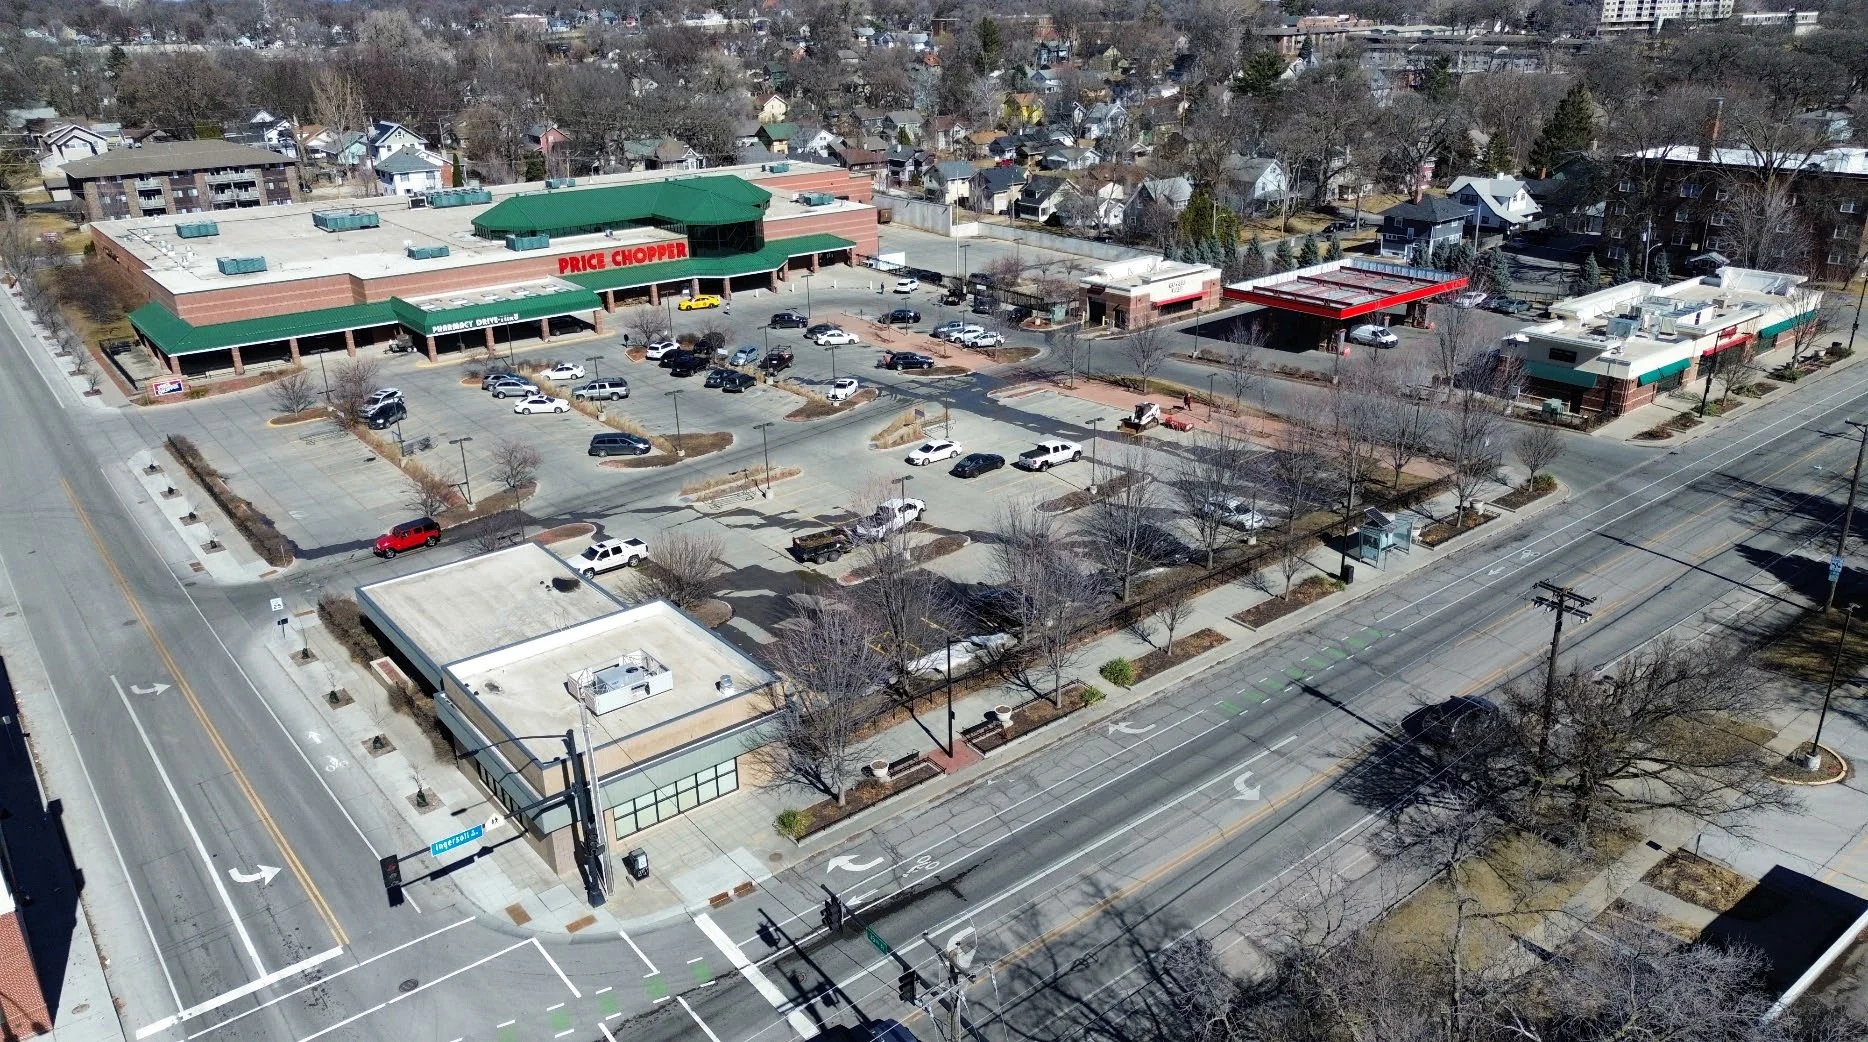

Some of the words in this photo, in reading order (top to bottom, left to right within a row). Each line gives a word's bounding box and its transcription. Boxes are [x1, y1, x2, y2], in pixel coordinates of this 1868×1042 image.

[558, 252, 606, 275] PRICE
[611, 242, 687, 266] CHOPPER
[432, 320, 474, 333] PHARMACY
[436, 831, 470, 851] Ingersoll
